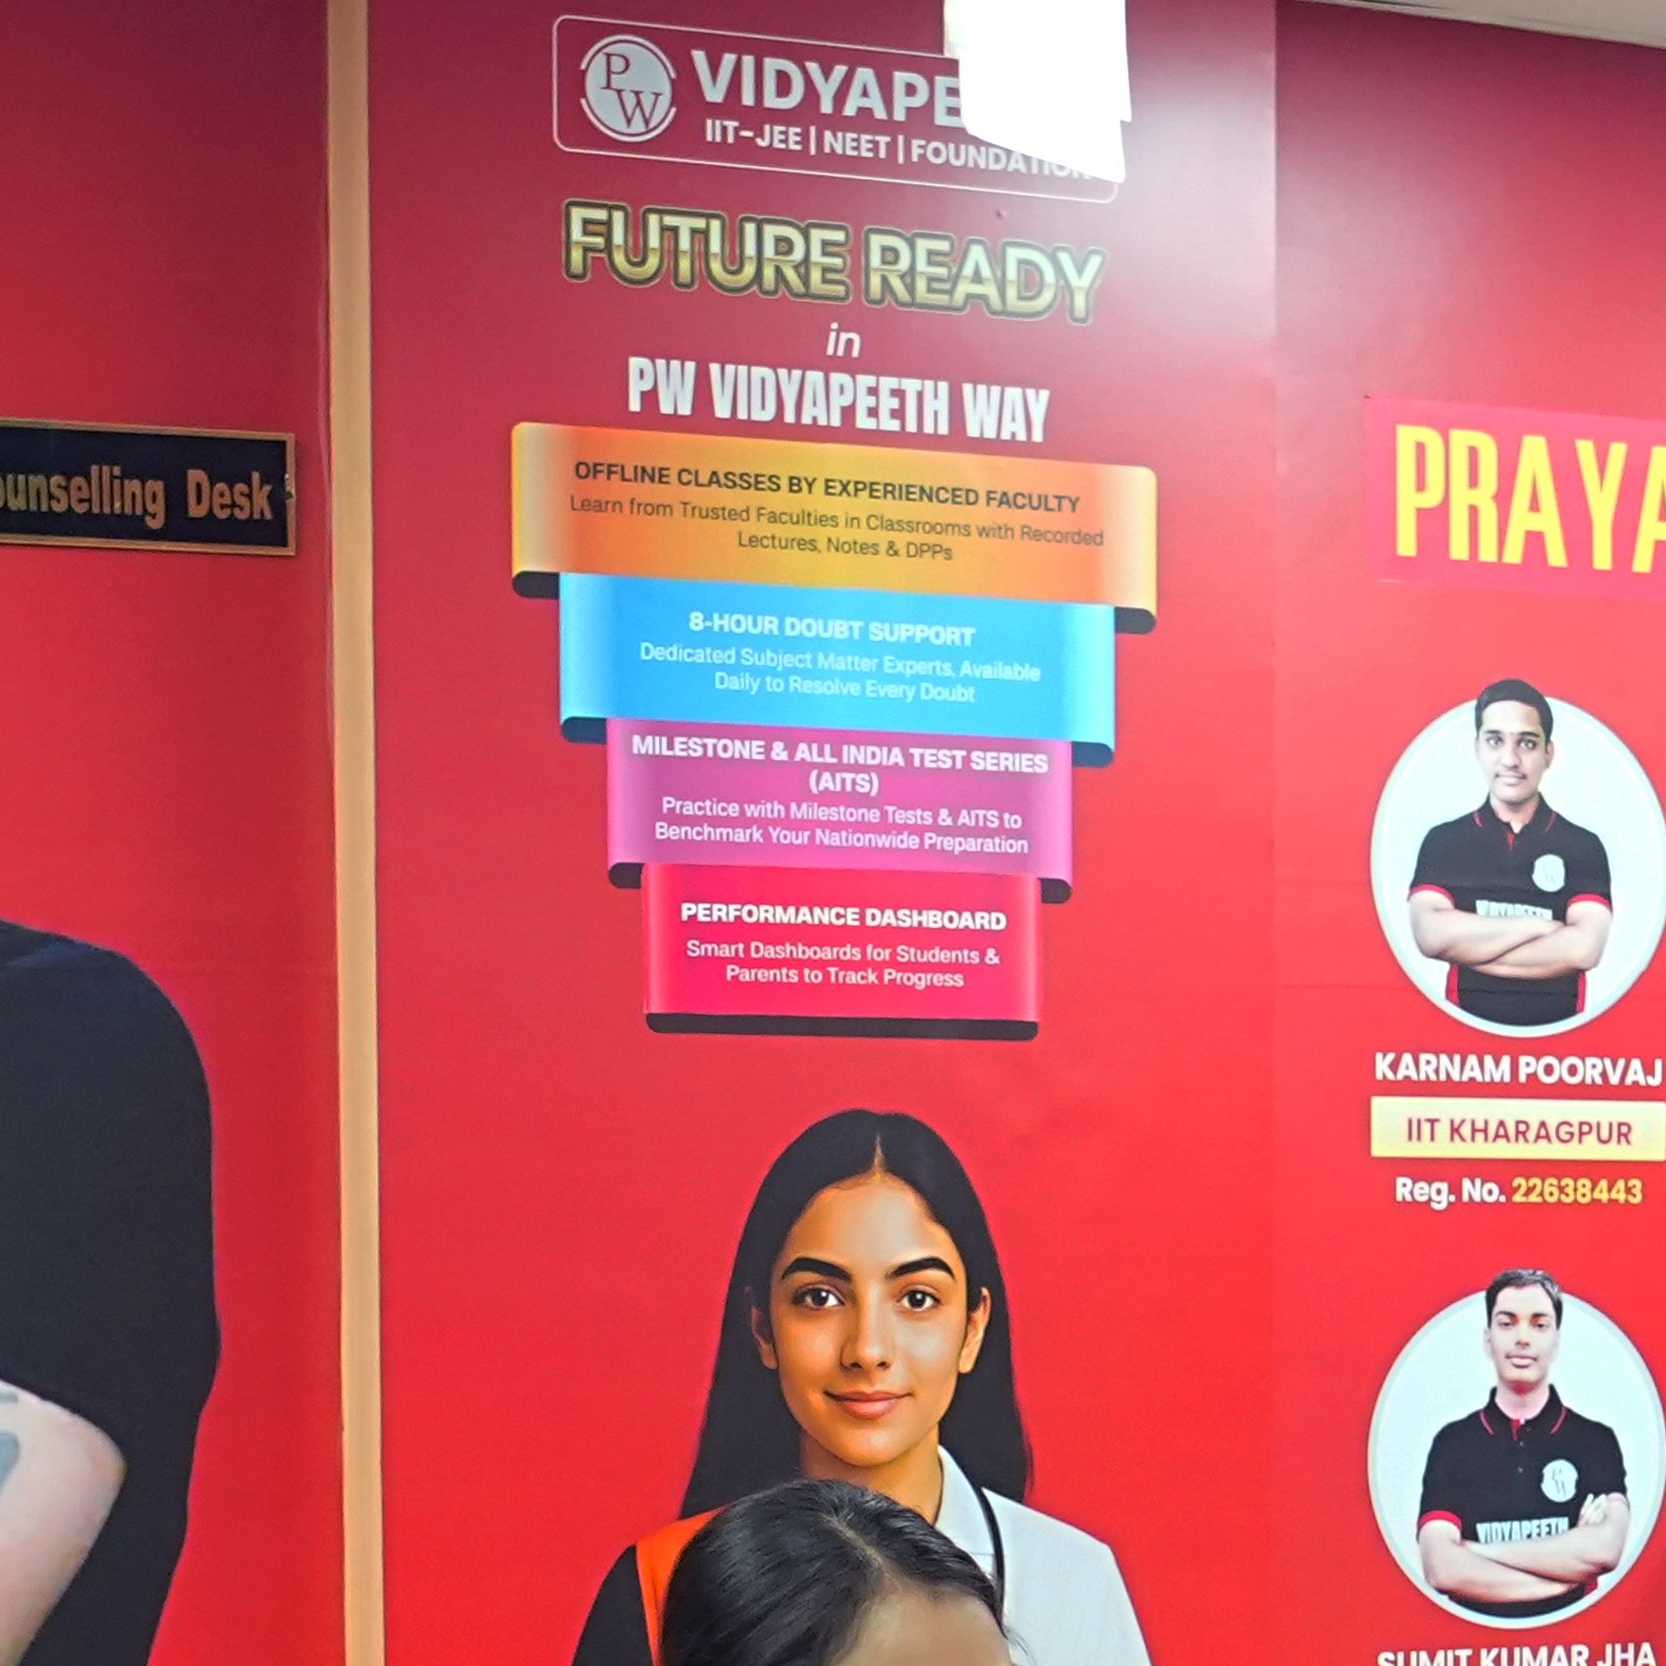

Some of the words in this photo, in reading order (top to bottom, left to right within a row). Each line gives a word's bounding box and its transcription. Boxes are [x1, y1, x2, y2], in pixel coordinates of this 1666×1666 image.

[692, 50, 963, 127] VIDYAPE
[706, 119, 802, 150] IIT-JEE
[824, 131, 890, 159] NEET
[563, 200, 852, 304] FUTURE
[863, 225, 1110, 324] READY
[826, 323, 861, 358] in
[628, 357, 695, 416] PW
[710, 363, 949, 436] VIDYAPEETH
[963, 383, 1050, 443] WAY
[187, 469, 273, 520] Desk
[574, 461, 671, 487] OFFLINE
[677, 467, 781, 494] CLASSES
[788, 475, 817, 495] BY
[824, 477, 980, 507] EXPERIENCED
[985, 489, 1081, 513] FACULTY
[570, 494, 625, 515] Learn
[630, 497, 673, 518] from
[681, 500, 750, 522] Trusted
[757, 505, 839, 529] Faculties
[845, 510, 860, 529] in
[867, 512, 972, 537] Classrooms
[977, 519, 1015, 540] with
[1021, 522, 1104, 547] Recorded
[827, 536, 879, 557] Notes
[906, 541, 953, 561] DPPs
[689, 611, 779, 636] 8-HOUR
[785, 616, 863, 640] DOUBT
[869, 622, 976, 647] SUPPORT
[641, 642, 735, 665] Dedicated
[741, 647, 813, 672] Subject
[818, 652, 877, 673] Matter
[961, 660, 1041, 682] Available
[714, 671, 759, 694] Daily
[765, 675, 784, 693] to
[790, 675, 859, 697] Resolve
[866, 679, 915, 703] Every
[920, 682, 975, 704] Doubt
[632, 734, 765, 762] MILESTONE
[795, 742, 838, 764] ALL
[842, 744, 904, 767] INDIA
[910, 747, 966, 770] TEST
[970, 751, 1049, 775] SERIES
[809, 769, 879, 796] (AITS)
[662, 797, 739, 818] Practice
[745, 799, 785, 819] with
[790, 802, 881, 824] Milestone
[885, 804, 933, 825] Tests
[957, 808, 1000, 829] AITS
[1004, 811, 1022, 829] to
[655, 822, 763, 844] Benchmark
[769, 826, 811, 846] Your
[815, 827, 920, 850] Nationwide
[924, 832, 1029, 855] Preparation
[681, 903, 860, 927] PERFORMANCE
[865, 907, 1007, 930] DASHBOARD
[686, 940, 745, 959] Smart
[750, 941, 862, 962] Dashboards
[866, 943, 892, 962] for
[896, 944, 979, 965] Students
[726, 966, 798, 984] Parents
[804, 967, 823, 984] to
[828, 966, 878, 986] Track
[883, 968, 964, 991] Progress
[1375, 1052, 1511, 1084] KARNAM
[1518, 1055, 1664, 1087] POORVAJ
[1407, 1117, 1441, 1144] IIT
[1449, 1118, 1633, 1146] KHARAGPUR
[1396, 1177, 1454, 1209] Reg.
[1462, 1178, 1505, 1203] No.
[1512, 1178, 1643, 1206] 22638443
